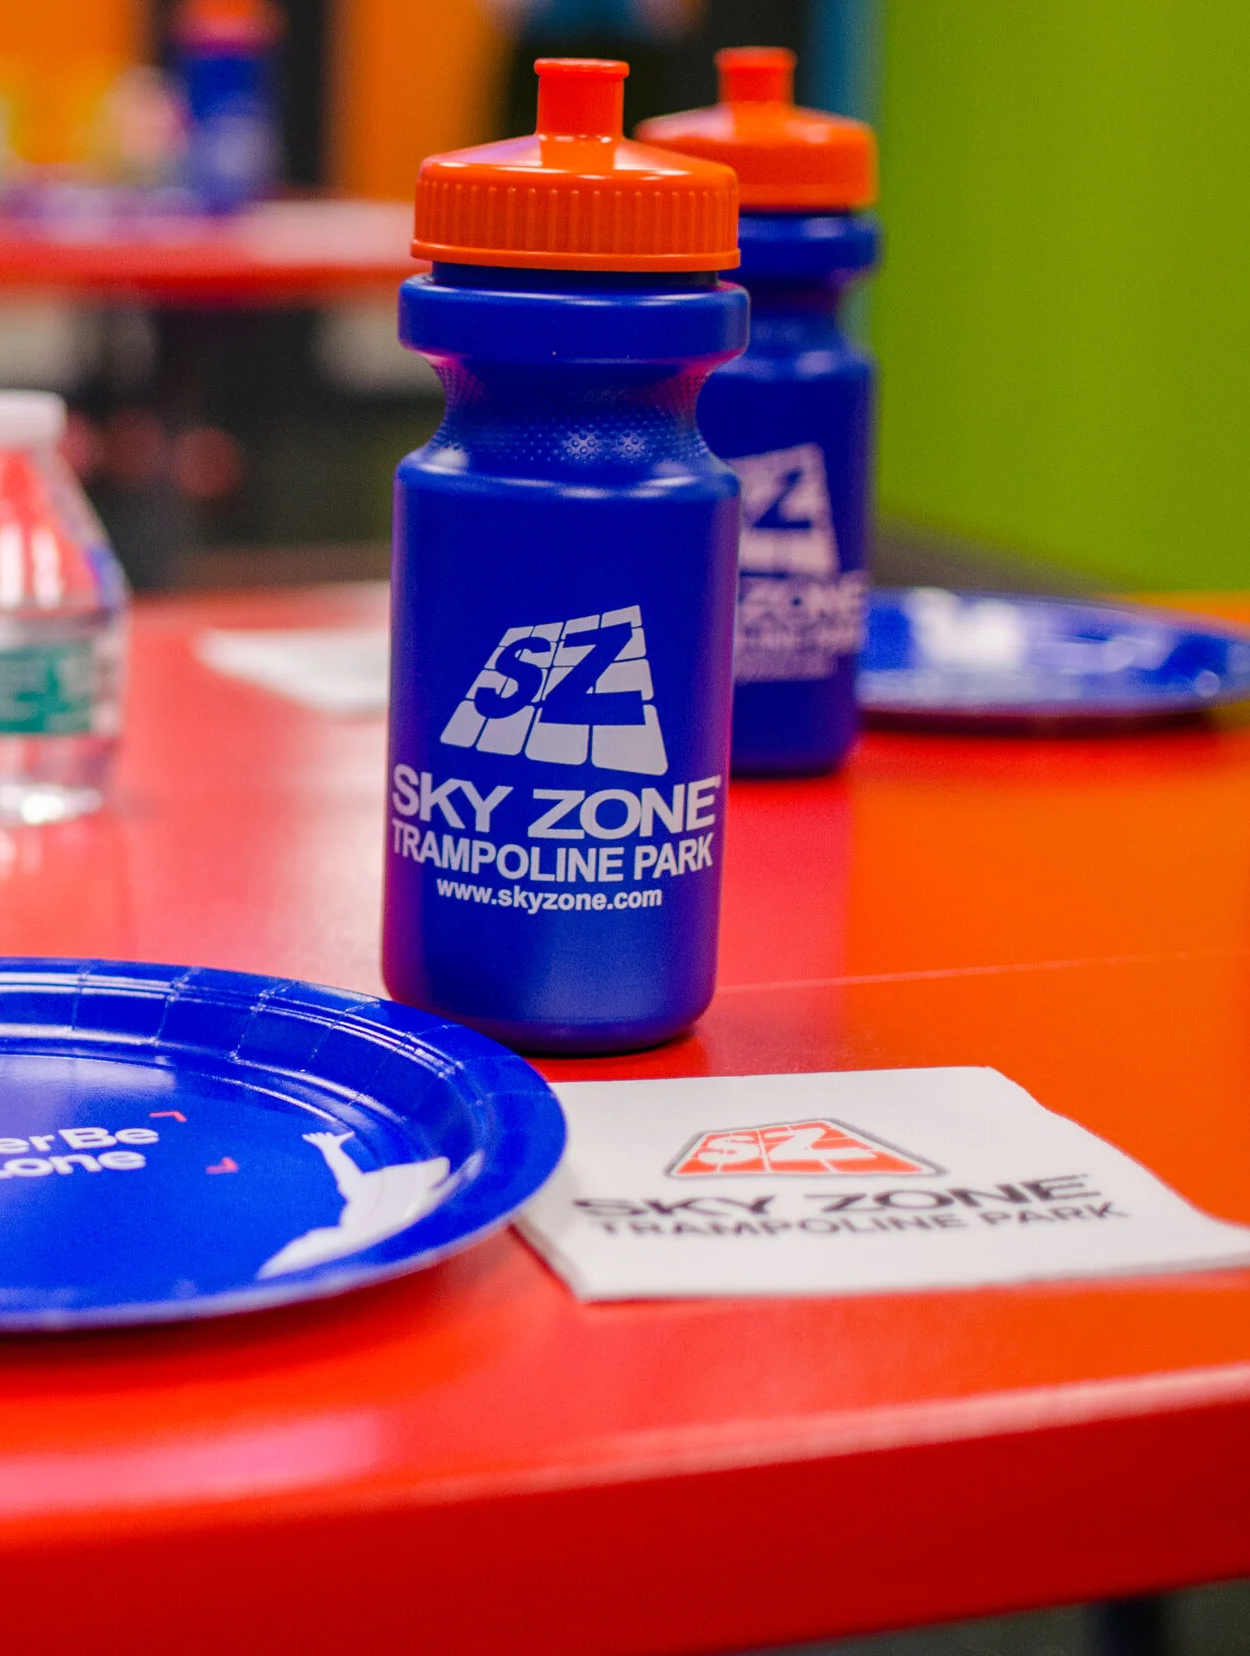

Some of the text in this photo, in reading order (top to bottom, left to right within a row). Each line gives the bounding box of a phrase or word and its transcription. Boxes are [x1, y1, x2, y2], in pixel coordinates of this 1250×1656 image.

[391, 763, 723, 841] SKY ZONE
[391, 818, 715, 884] TRAMPOLINE PARK
[436, 878, 663, 916] www.skyzone.com
[574, 1173, 1102, 1218] SKY ZONE
[588, 1200, 1129, 1240] TRAMPOLINE PARK
